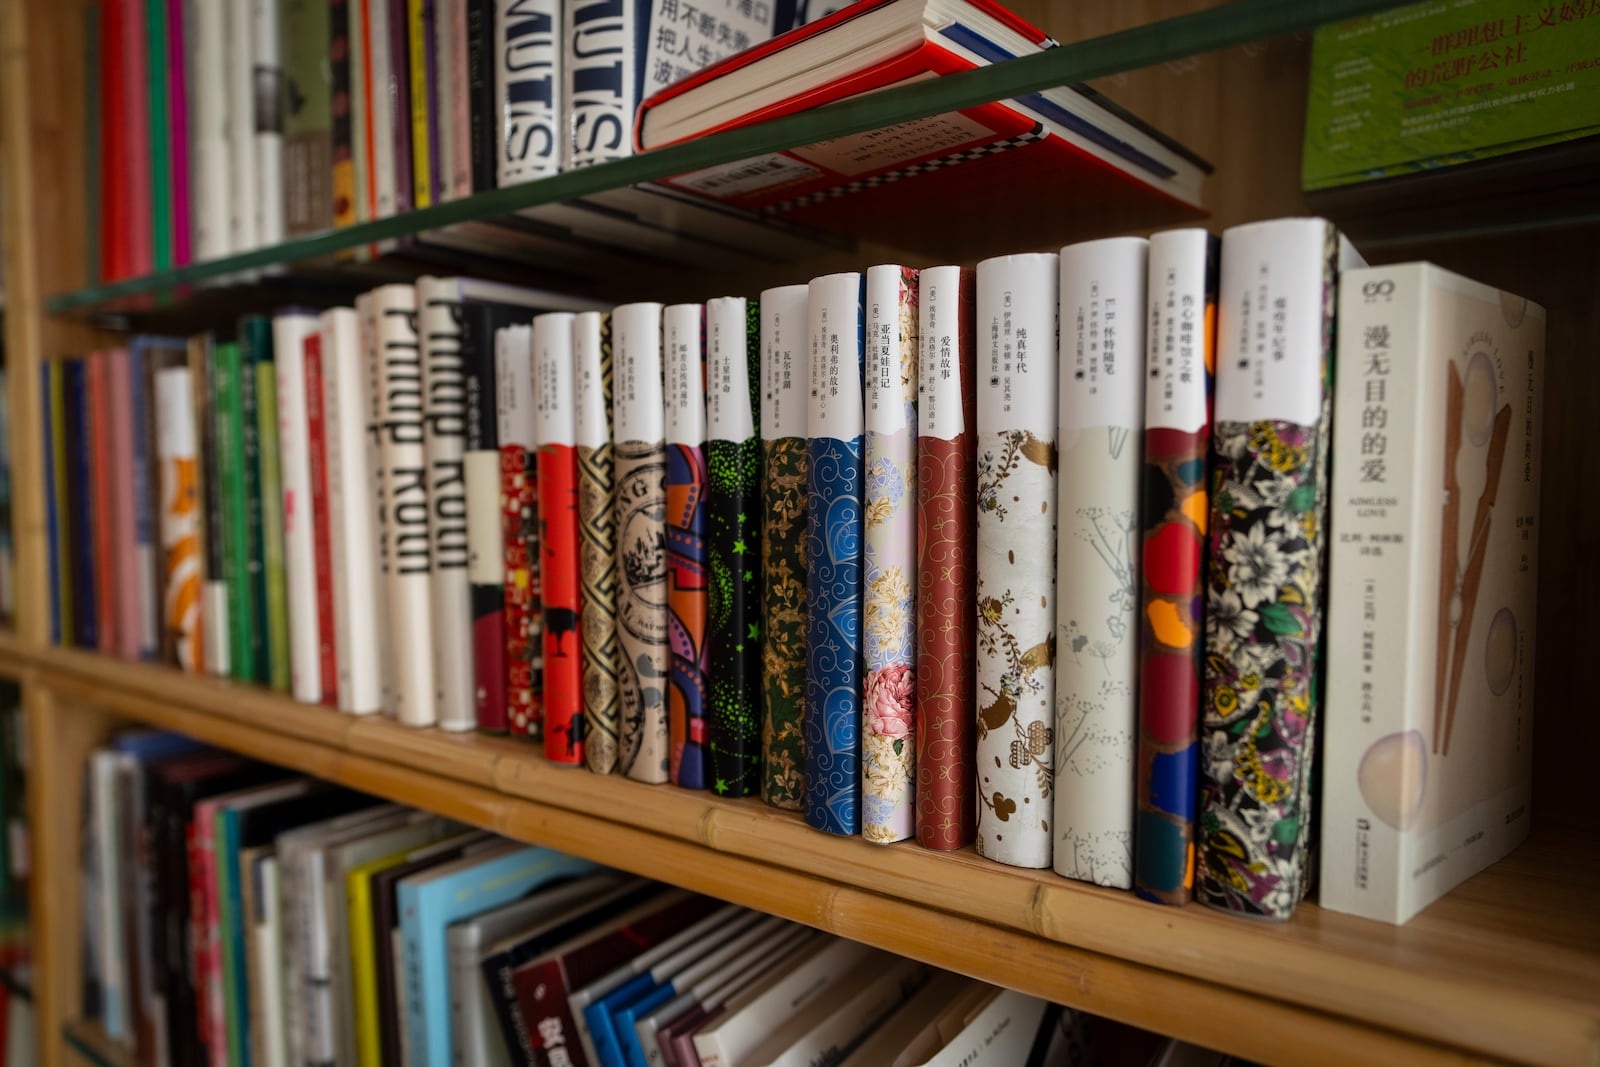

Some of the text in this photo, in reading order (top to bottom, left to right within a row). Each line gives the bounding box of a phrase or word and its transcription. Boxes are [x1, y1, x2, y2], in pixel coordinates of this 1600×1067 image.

[656, 25, 724, 67] 把人生
[783, 350, 792, 390] 瓦尔登湖
[829, 334, 839, 398] 奥利弗的故事
[880, 324, 890, 389] 亚当夏娃日记
[940, 336, 951, 380] 爱情故事
[1016, 328, 1027, 373] 纯真年代
[1360, 325, 1391, 483] 漫无目的的爱
